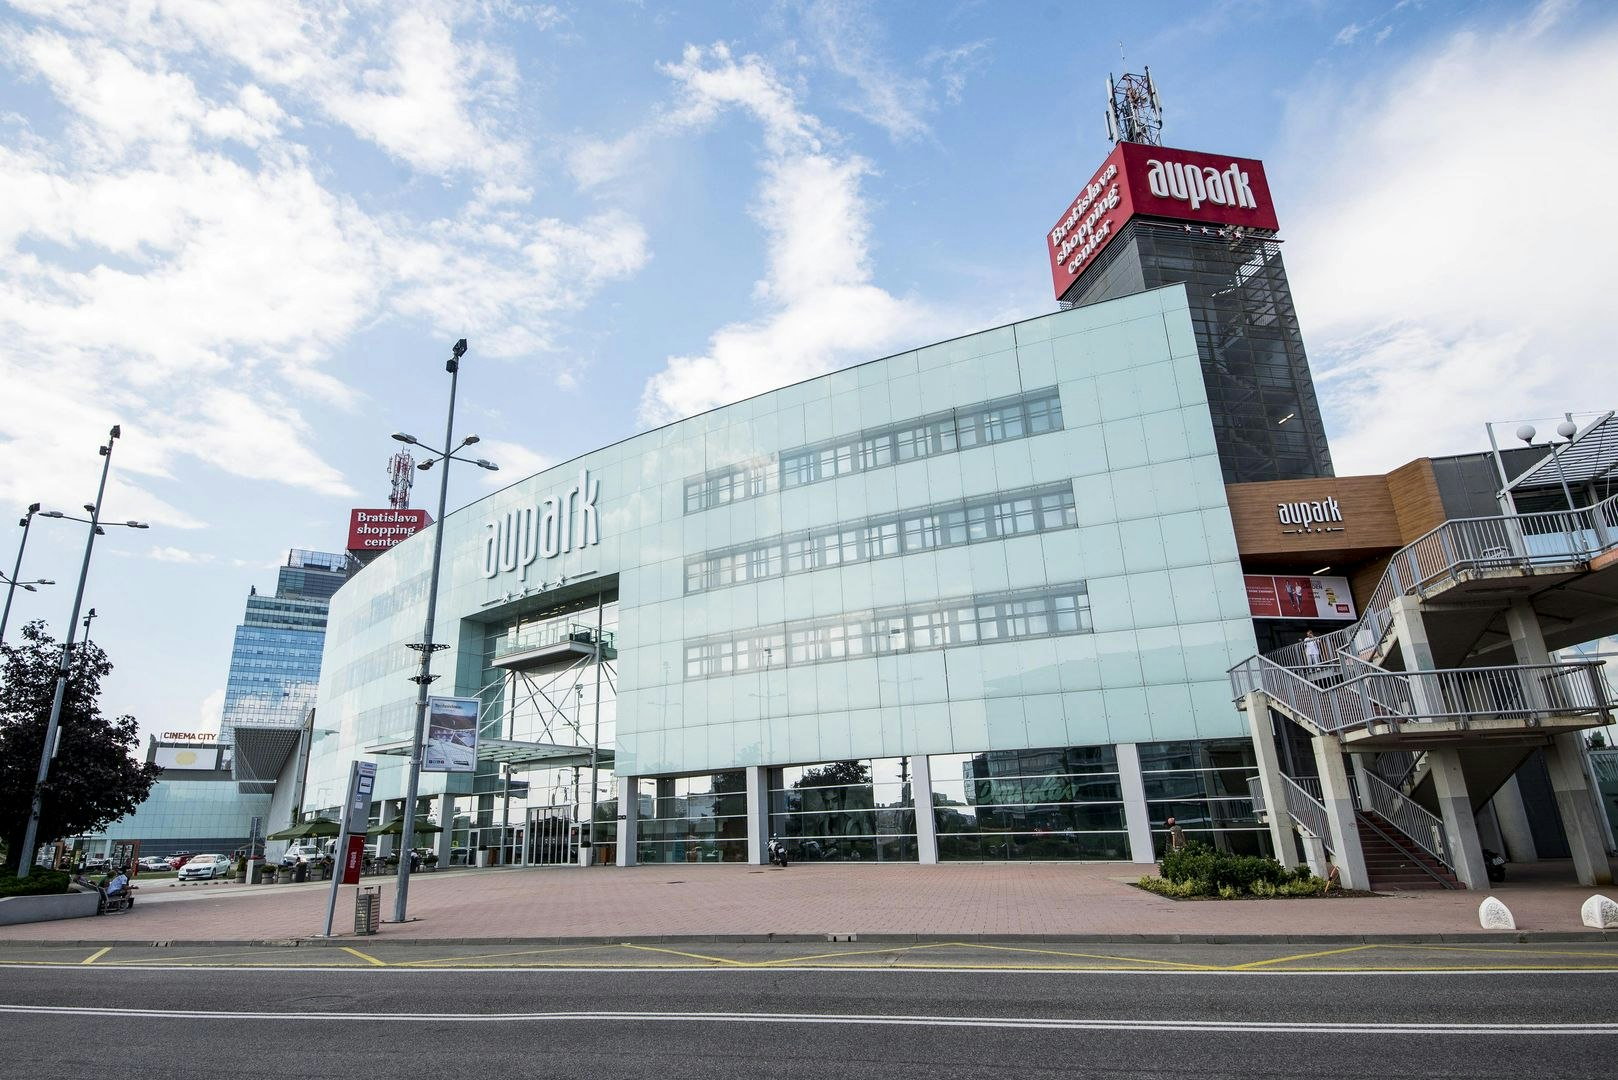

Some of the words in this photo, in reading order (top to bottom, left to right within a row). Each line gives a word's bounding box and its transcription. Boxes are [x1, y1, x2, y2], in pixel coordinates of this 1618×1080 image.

[1051, 163, 1118, 247] Bratislava
[1146, 159, 1257, 210] aupark
[1056, 183, 1120, 266] shopping
[1067, 219, 1112, 275] center
[357, 511, 418, 523] Bratislava
[357, 523, 416, 537] shopping
[482, 468, 600, 582] aupark
[1278, 495, 1343, 528] aupark
[163, 732, 197, 740] CINEMA
